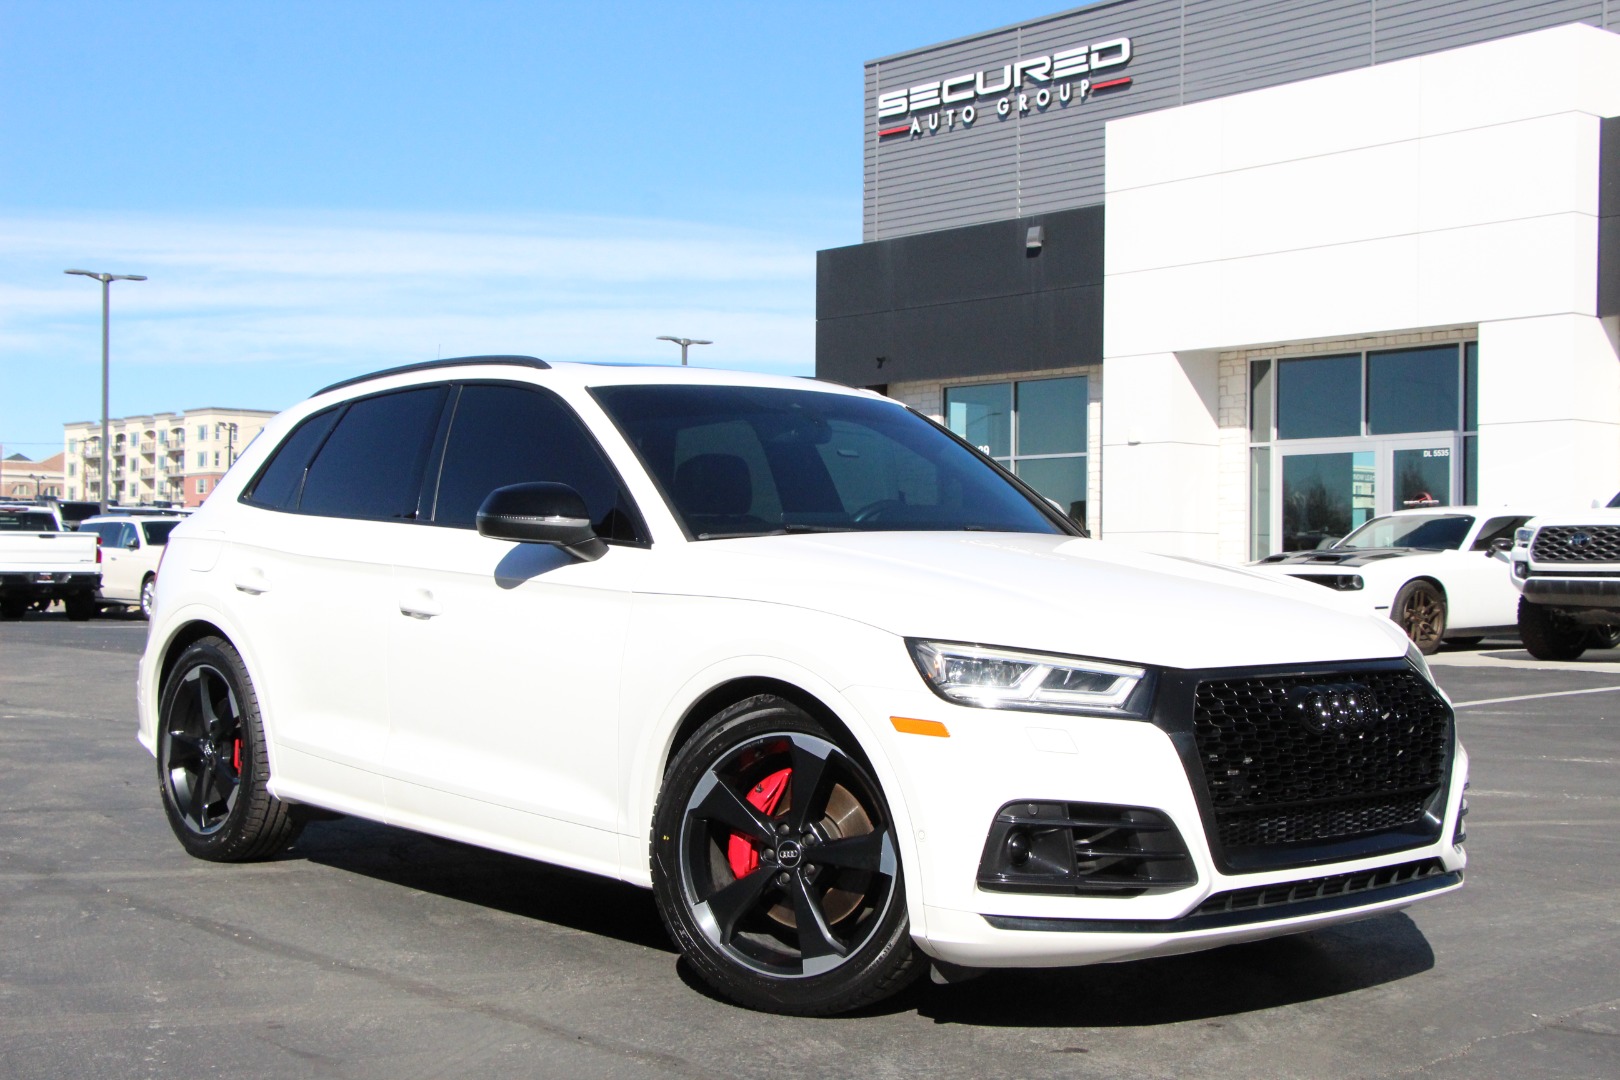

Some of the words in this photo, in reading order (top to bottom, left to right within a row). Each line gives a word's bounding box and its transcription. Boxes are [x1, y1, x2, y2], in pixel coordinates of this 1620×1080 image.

[878, 37, 1131, 118] SECURED
[910, 105, 975, 135] AUTO
[997, 79, 1090, 115] GROUP
